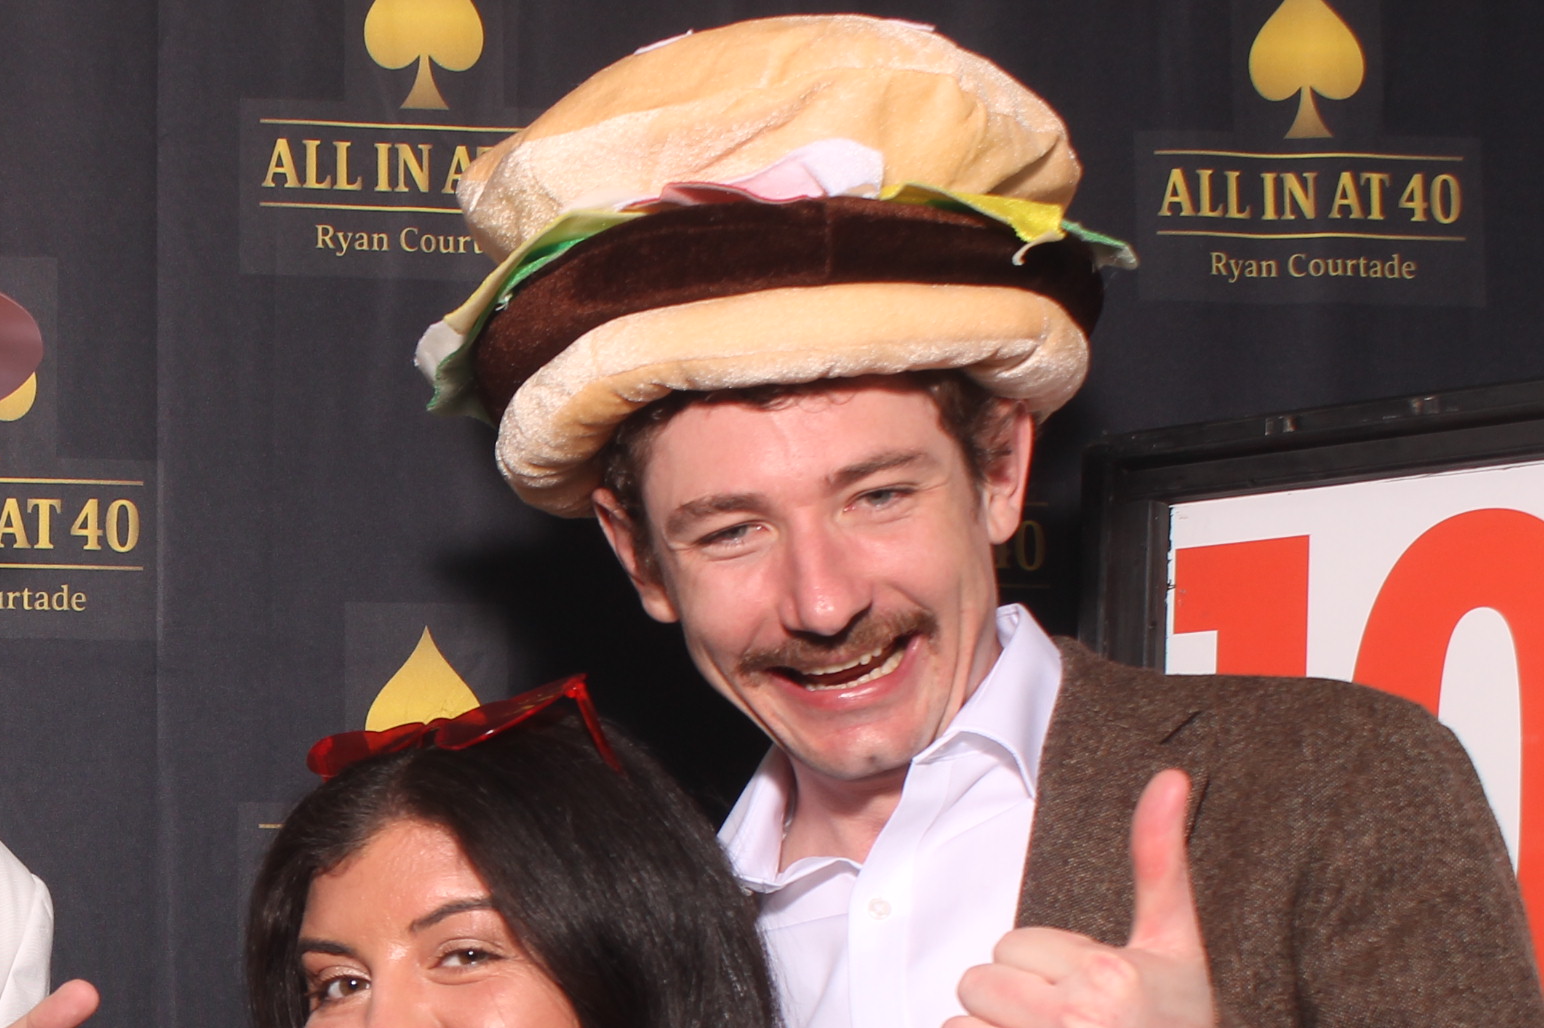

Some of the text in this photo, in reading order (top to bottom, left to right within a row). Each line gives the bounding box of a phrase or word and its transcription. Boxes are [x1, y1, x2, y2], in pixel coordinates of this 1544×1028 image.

[262, 137, 494, 195] ALL IN A
[1158, 167, 1462, 225] ALL IN AT 40
[316, 224, 389, 256] Ryan
[1210, 251, 1417, 283] Ryan Courtade
[70, 498, 141, 553] 40
